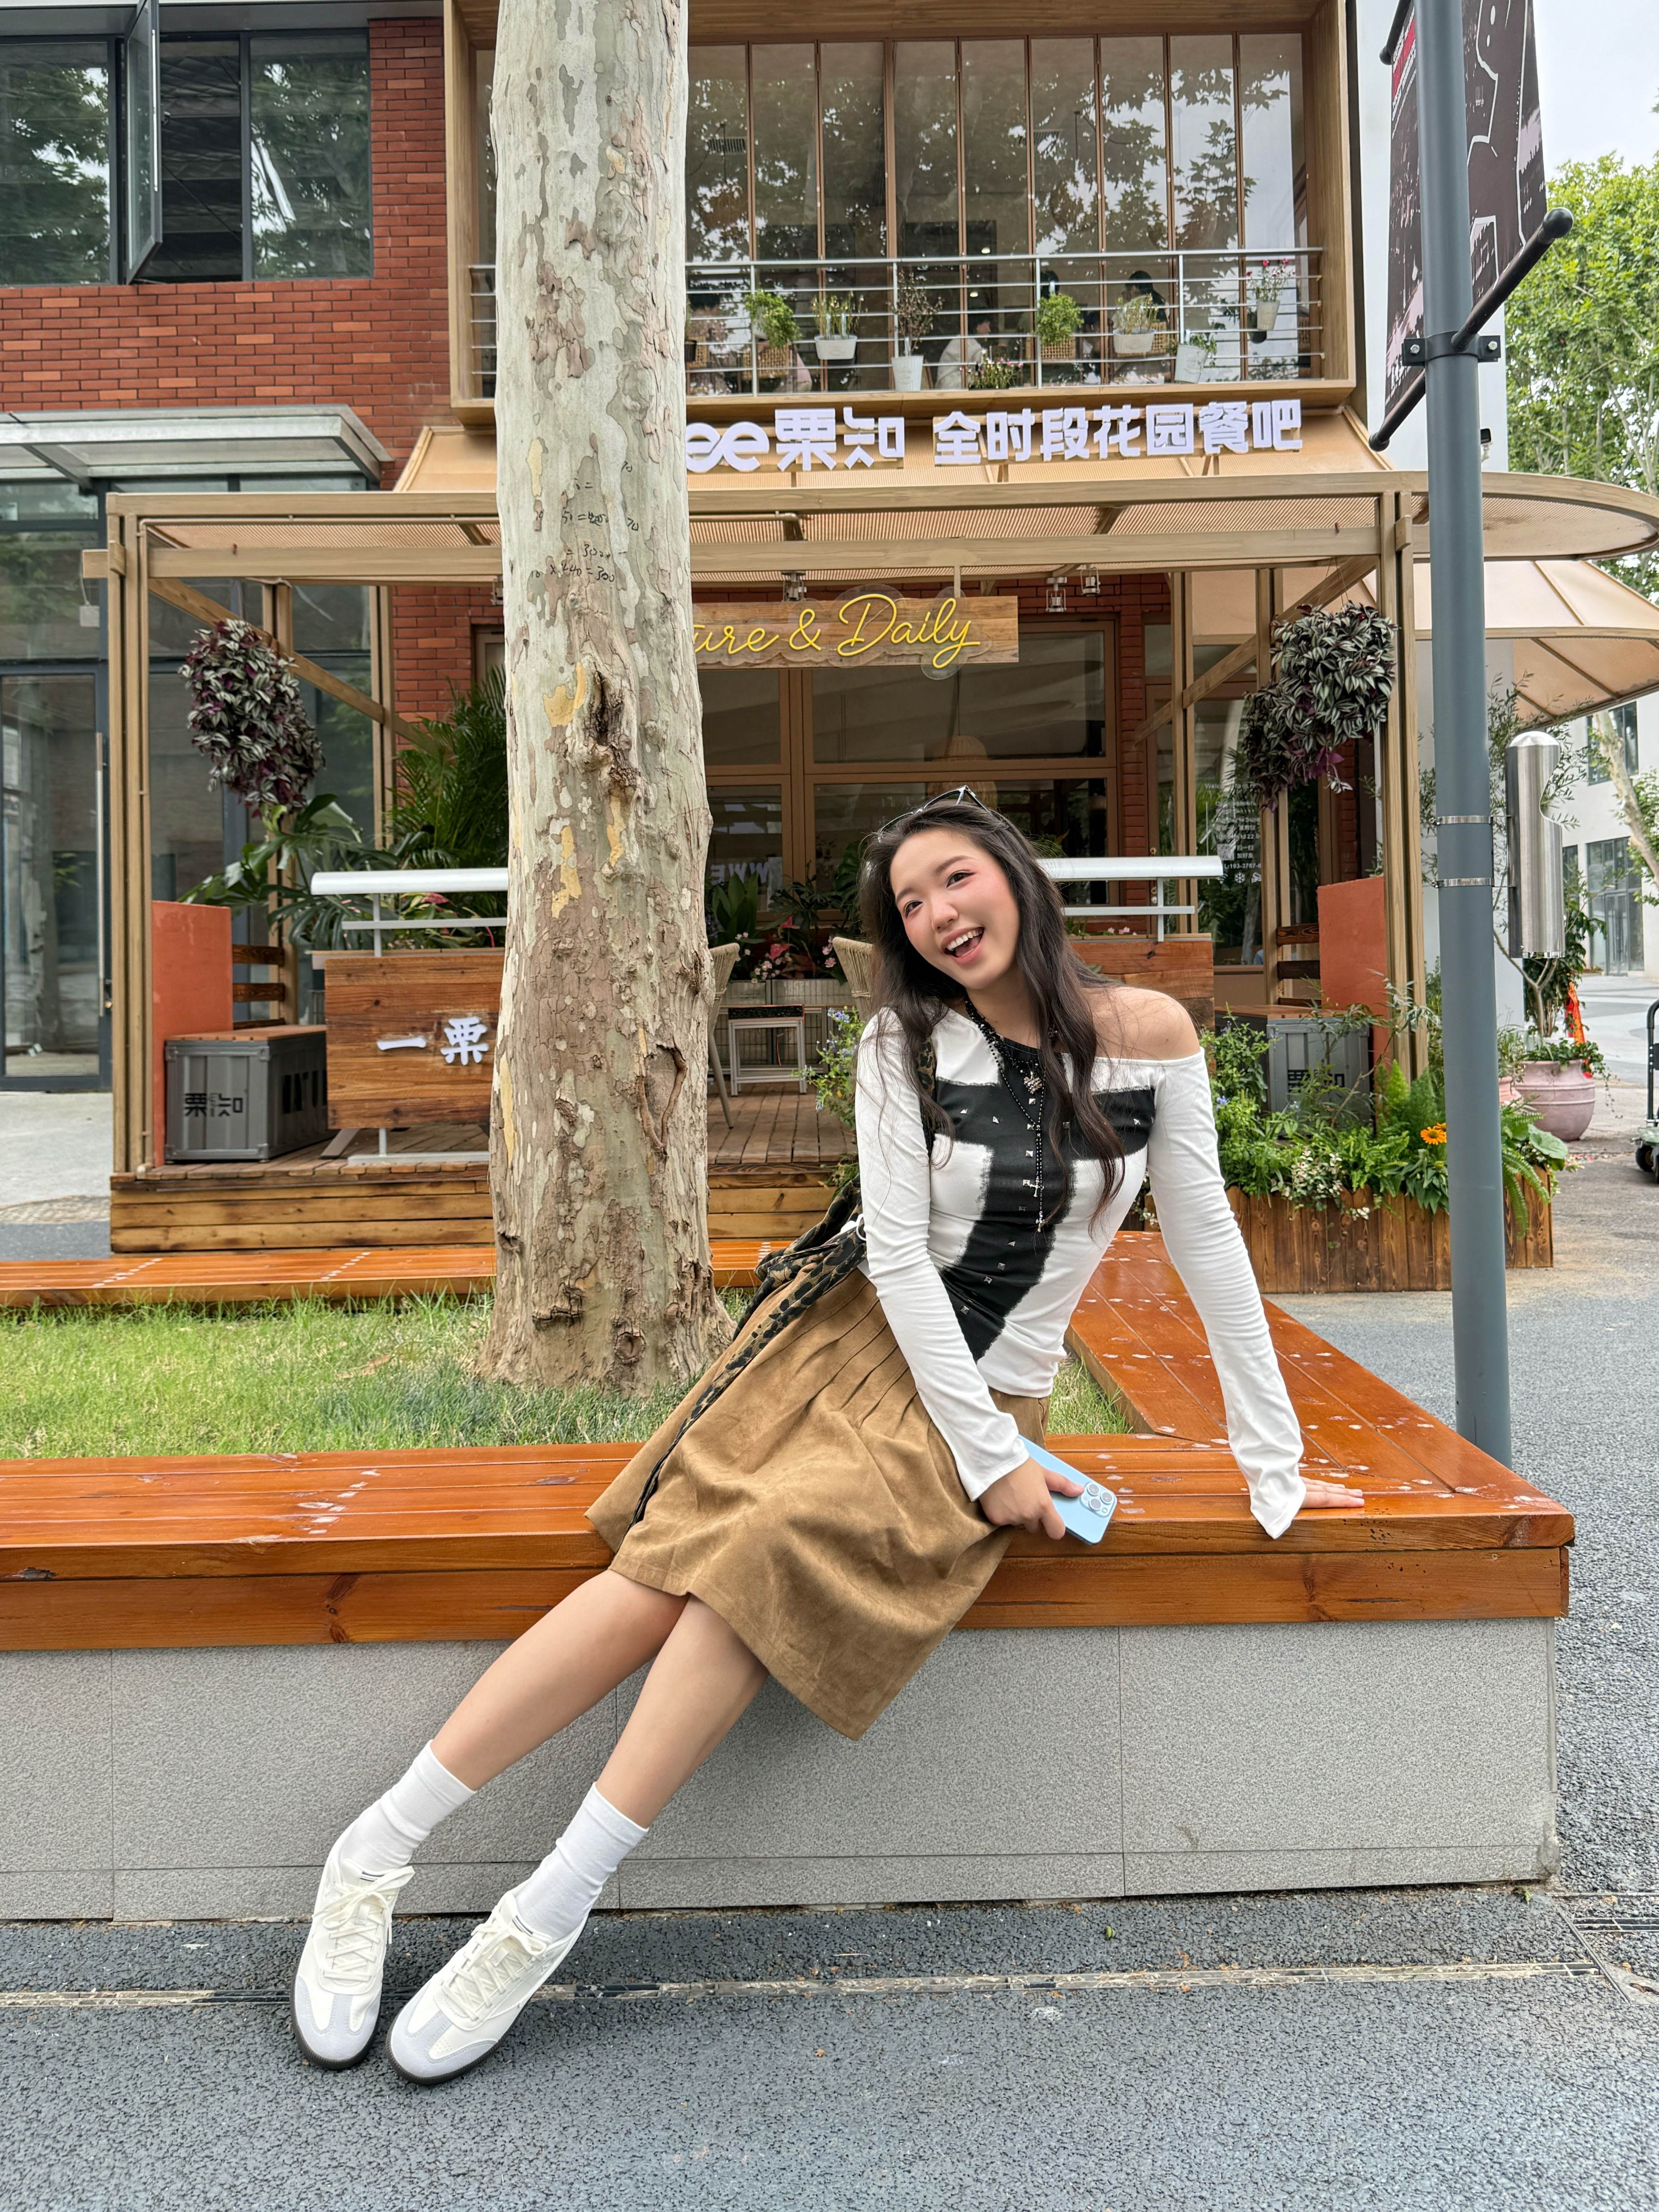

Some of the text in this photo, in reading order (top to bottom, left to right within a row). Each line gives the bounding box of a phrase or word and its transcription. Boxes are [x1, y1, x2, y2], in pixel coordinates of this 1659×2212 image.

[933, 398, 1303, 465] 全时段花园餐吧
[789, 608, 821, 651] &
[837, 593, 981, 669] Daily
